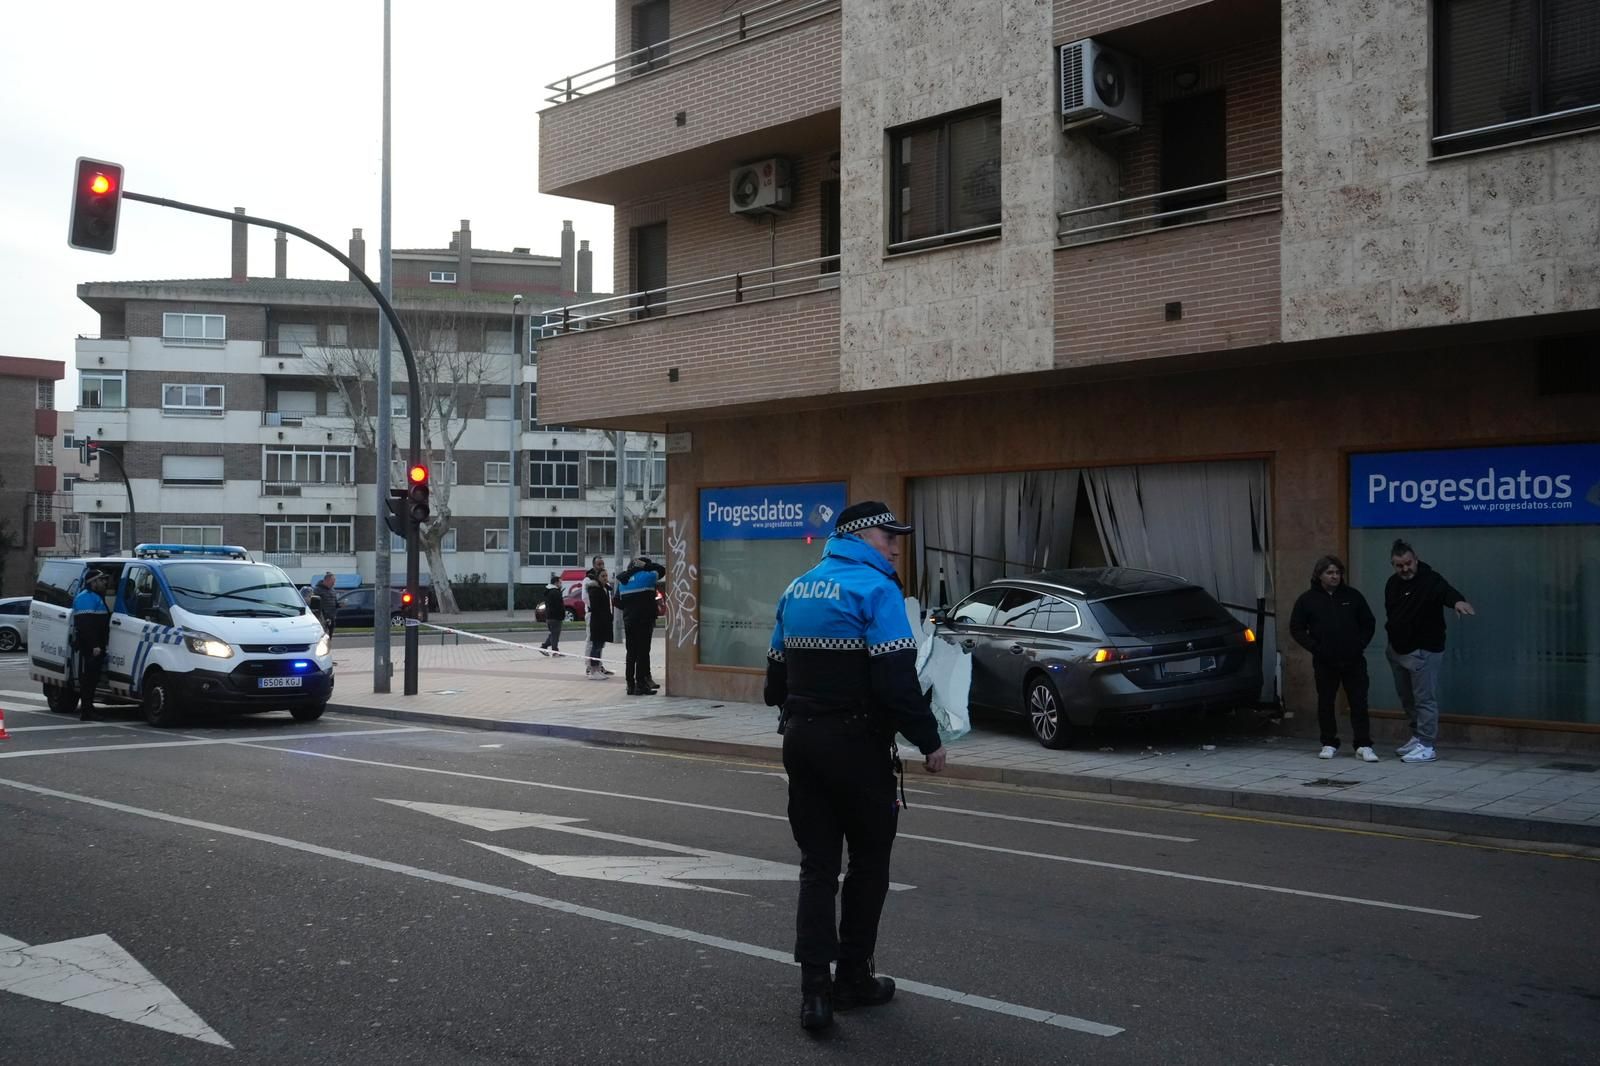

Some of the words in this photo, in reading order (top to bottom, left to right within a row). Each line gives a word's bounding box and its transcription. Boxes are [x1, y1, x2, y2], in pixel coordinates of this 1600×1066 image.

[1369, 467, 1573, 509] Progesdatos
[708, 497, 804, 527] Progesdatos
[1463, 501, 1573, 512] www.progesdatos.com
[752, 520, 804, 529] www.progesdatos.com
[785, 578, 841, 601] POLICÍA
[263, 679, 283, 687] 6506
[285, 678, 300, 686] KGJ
